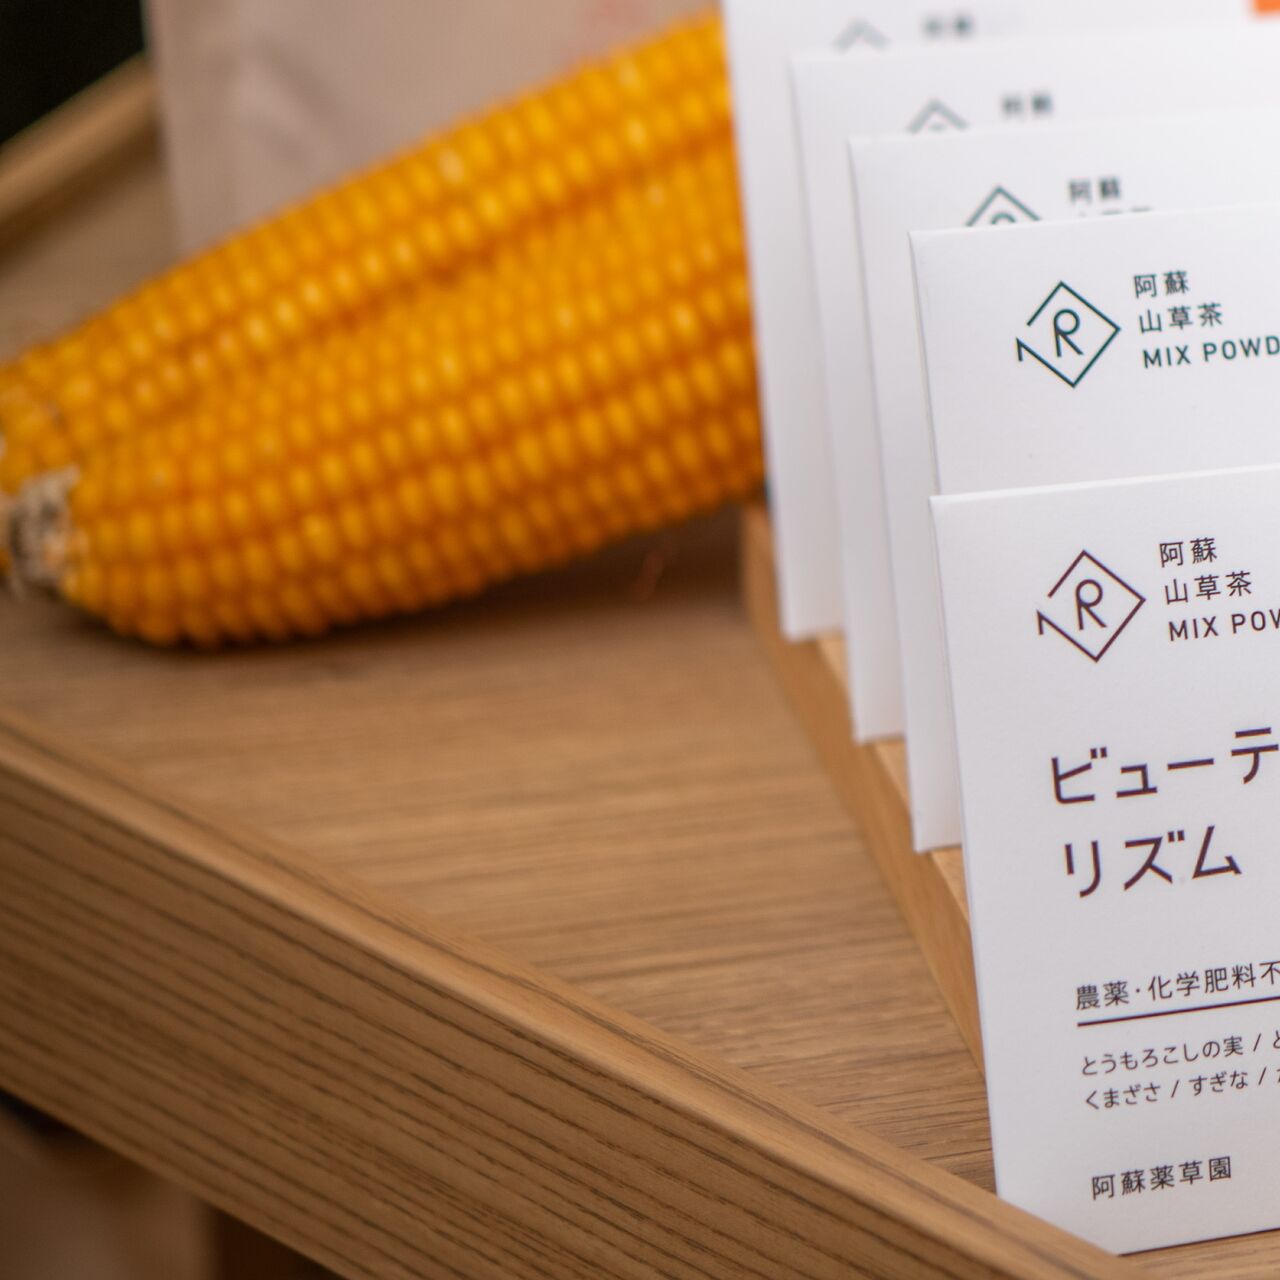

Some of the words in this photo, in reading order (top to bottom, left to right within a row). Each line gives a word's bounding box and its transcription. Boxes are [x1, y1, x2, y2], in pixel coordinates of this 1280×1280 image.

[1134, 270, 1190, 298] 阿蘇
[1138, 303, 1224, 334] 山草茶
[1142, 346, 1191, 370] MIX
[1158, 536, 1219, 568] 阿蘇
[1164, 570, 1253, 605] 山草茶
[1168, 615, 1219, 642] MIX
[1064, 825, 1243, 899] リズム
[1091, 1156, 1233, 1201] 阿蘇薬草園
